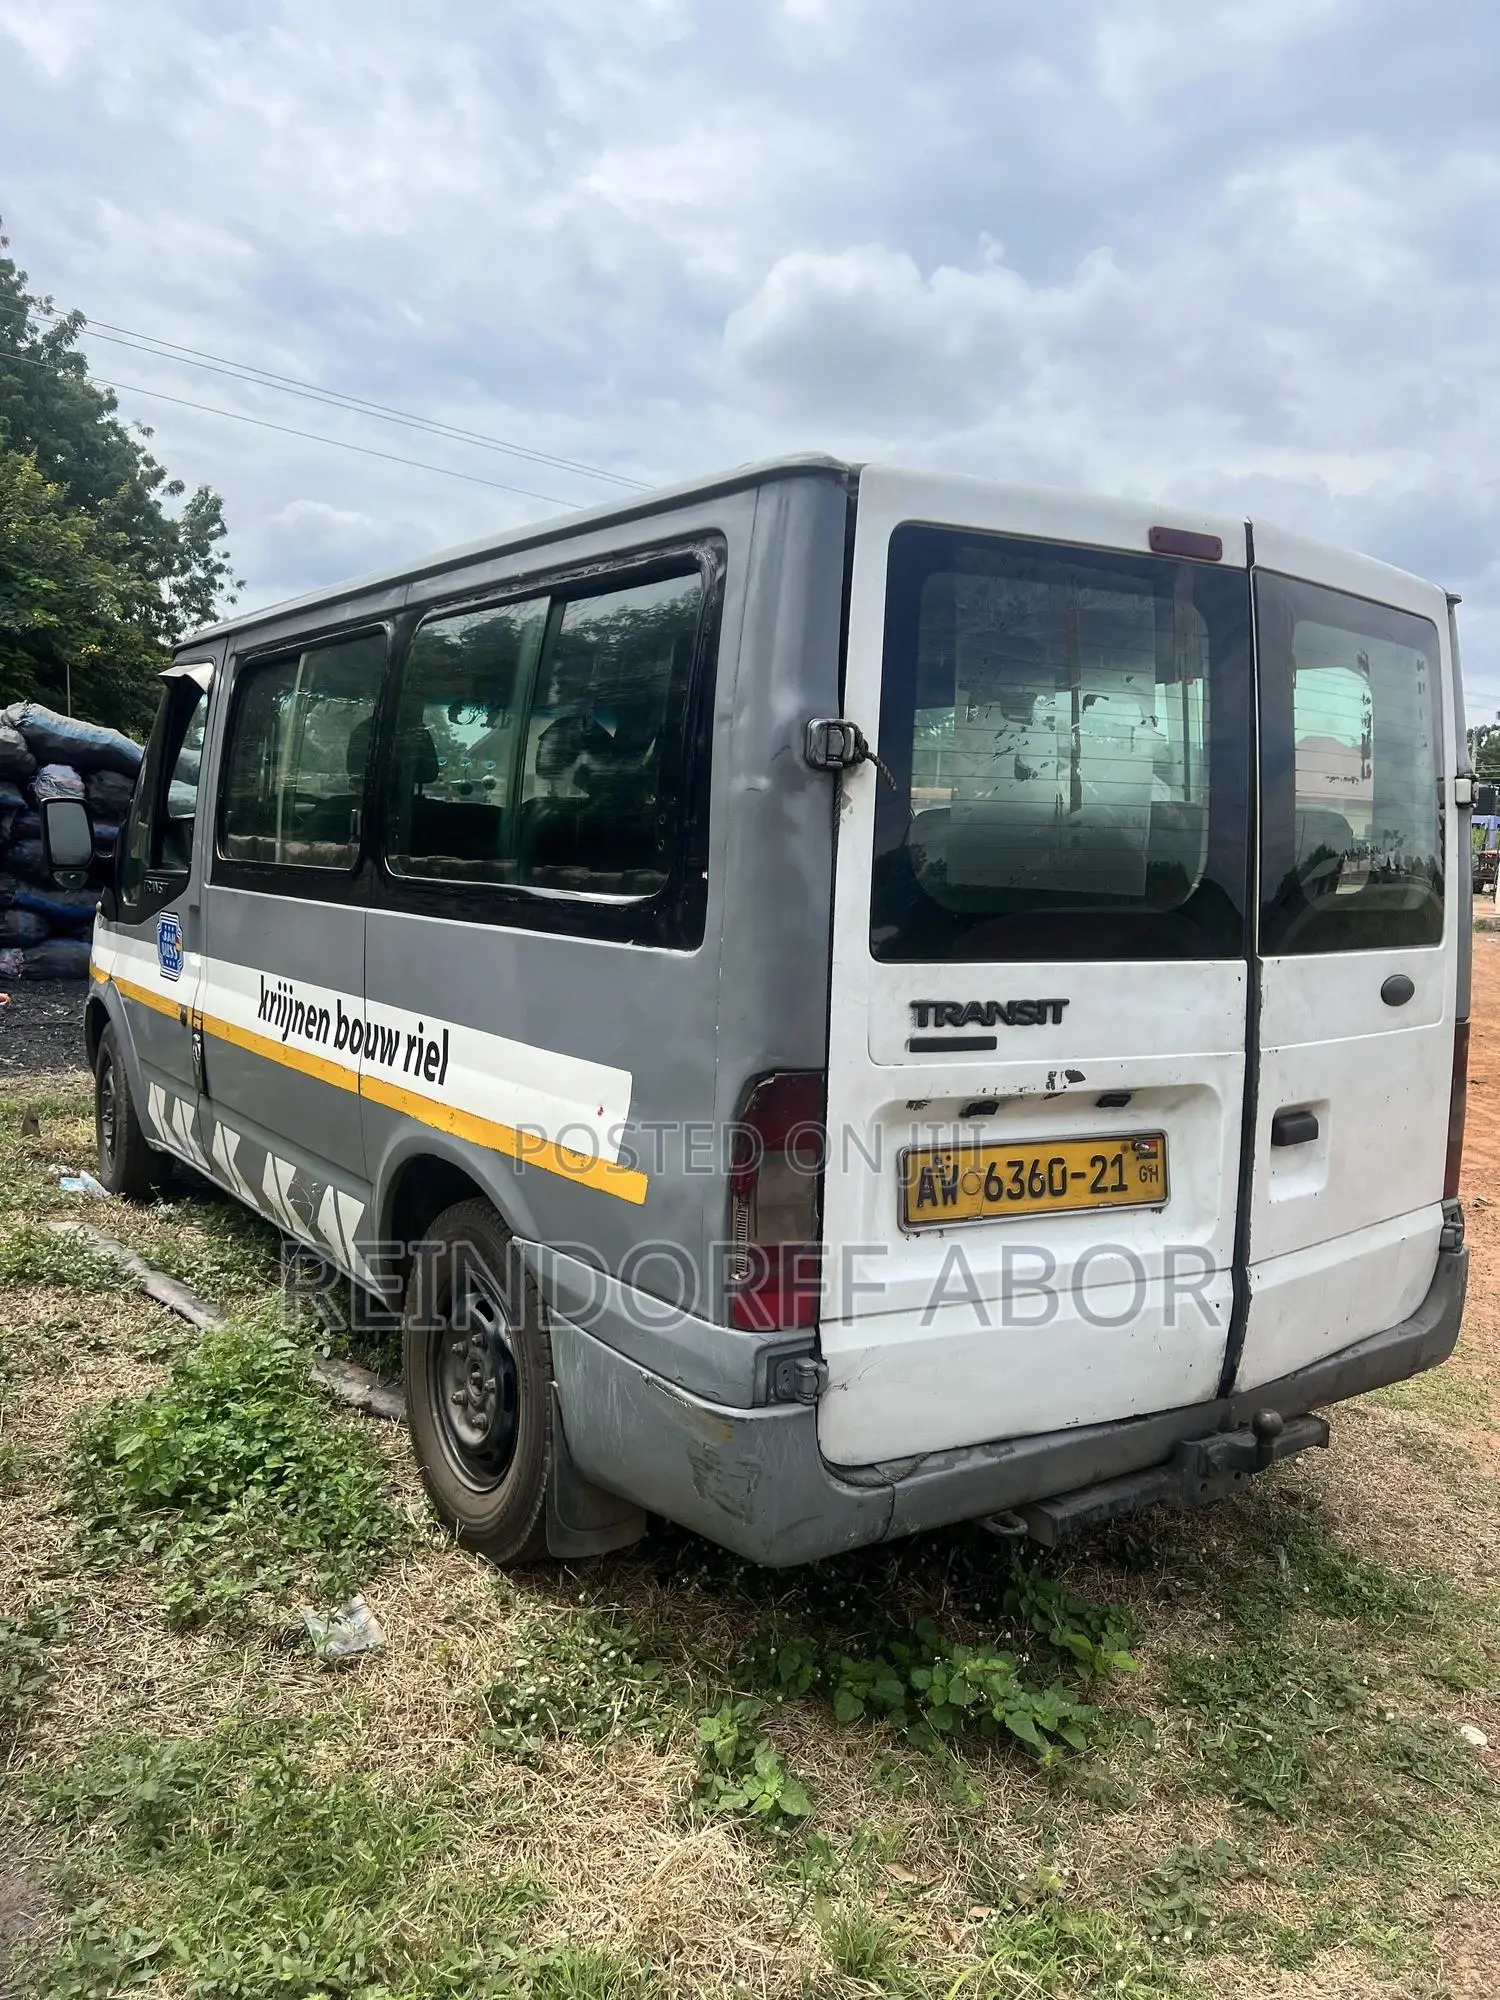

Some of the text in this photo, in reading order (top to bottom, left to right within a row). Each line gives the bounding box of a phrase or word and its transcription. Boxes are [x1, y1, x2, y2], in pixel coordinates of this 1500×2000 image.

[258, 975, 449, 1085] kriijnen bouw riel
[909, 998, 1070, 1028] TRANSIT
[917, 1153, 1128, 1208] AW 6360-21
[1139, 1165, 1158, 1183] GH
